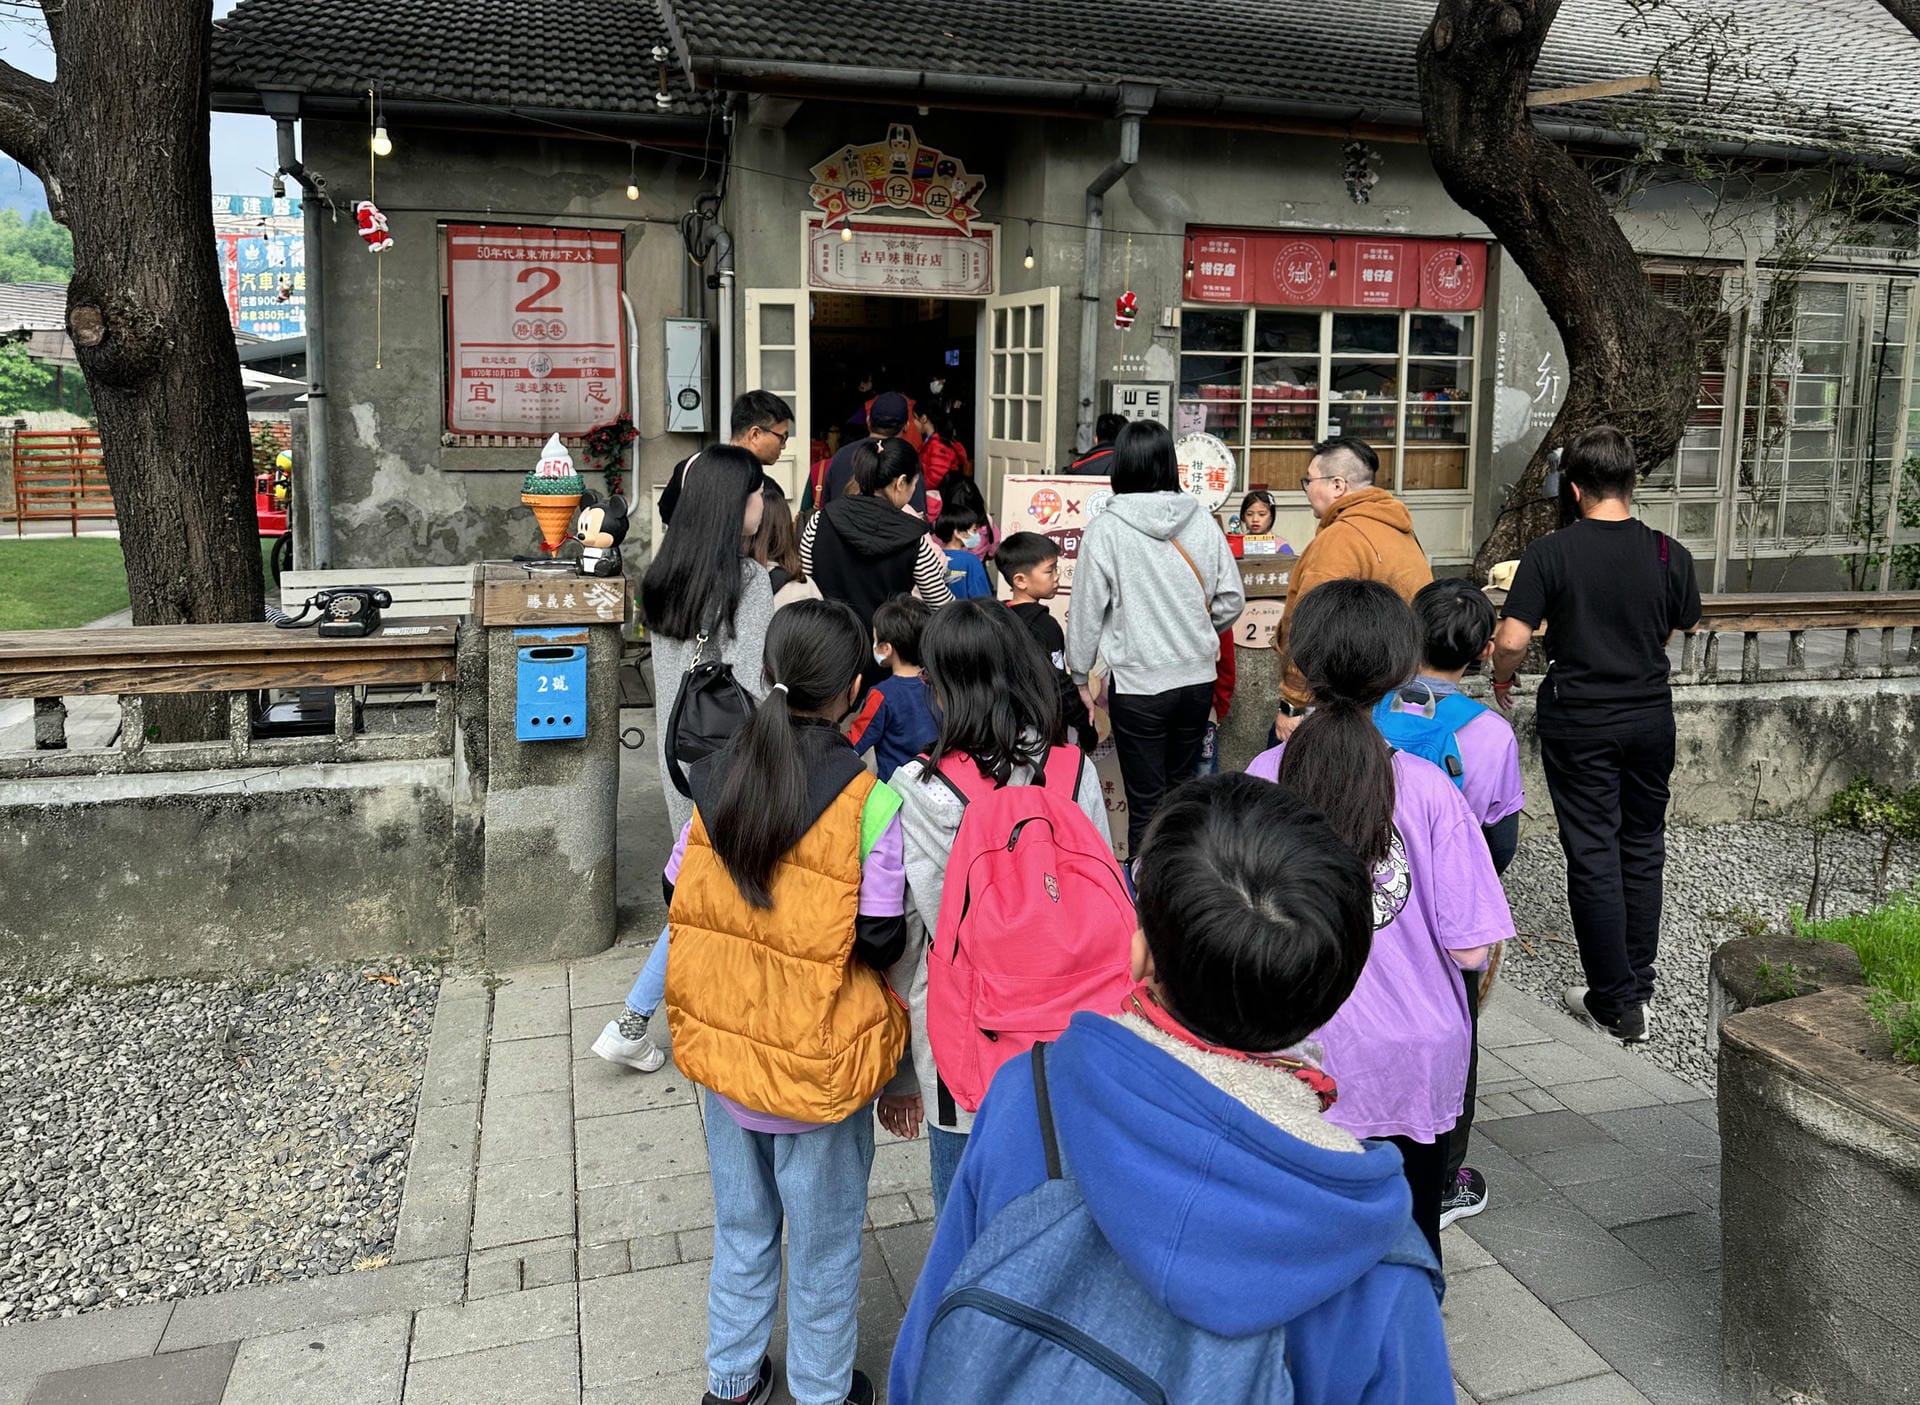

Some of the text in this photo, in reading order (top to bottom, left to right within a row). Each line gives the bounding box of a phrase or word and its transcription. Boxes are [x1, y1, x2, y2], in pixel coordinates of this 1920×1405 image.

[848, 183, 948, 208] 柑仔店
[477, 246, 594, 261] 50年代屏東市鄉下人家
[860, 250, 943, 267] 古早味柑仔店
[1200, 261, 1236, 277] 柑仔店
[1362, 268, 1394, 283] 柑仔店
[515, 266, 564, 313] 2
[515, 321, 565, 338] 勝義巷
[467, 381, 497, 404] 宜
[584, 381, 611, 404] 忌
[1191, 460, 1203, 495] 柑仔店
[1204, 465, 1230, 491] 舊
[527, 593, 577, 609] 勝義巷
[1246, 623, 1257, 640] 2
[537, 674, 569, 693] 2號
